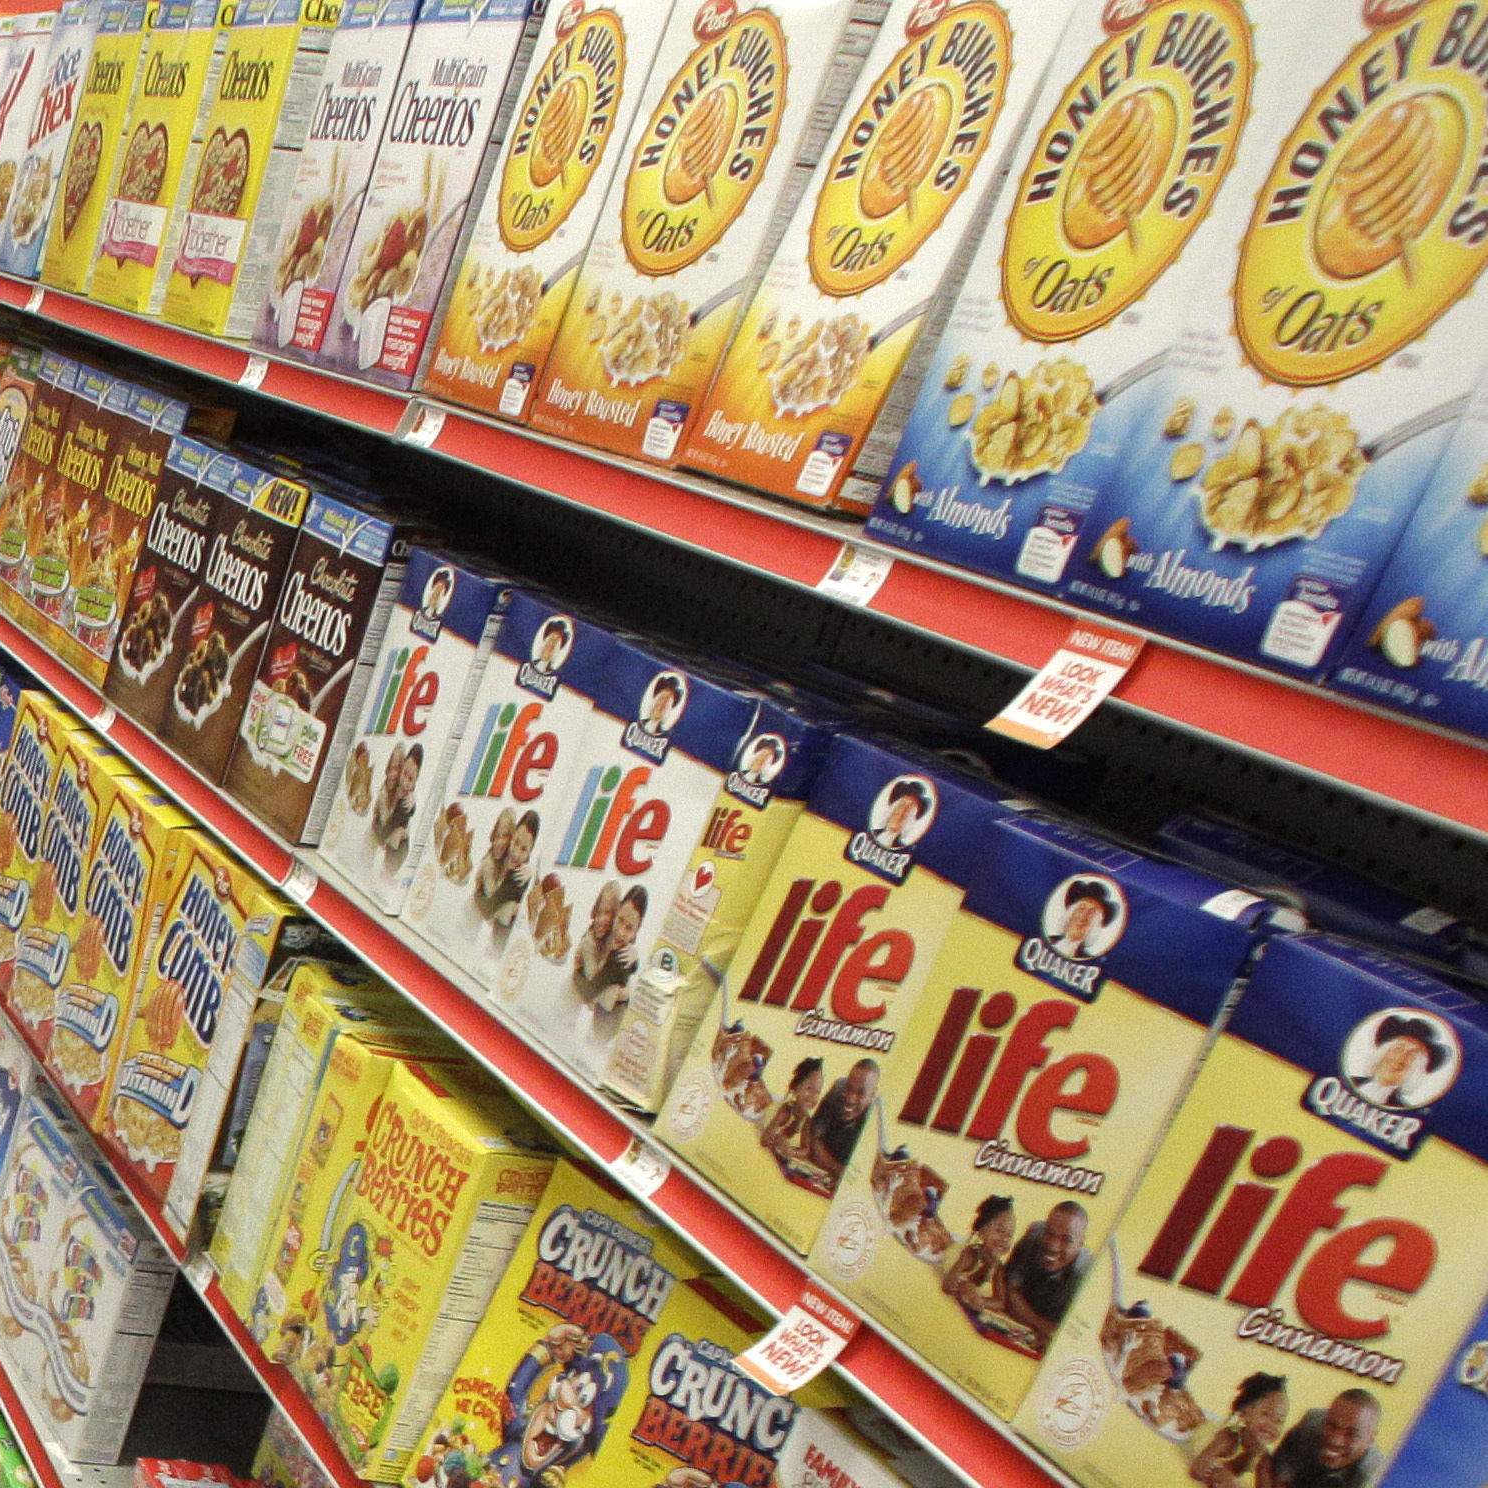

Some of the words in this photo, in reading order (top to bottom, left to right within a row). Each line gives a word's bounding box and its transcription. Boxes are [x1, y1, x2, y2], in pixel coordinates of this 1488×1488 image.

[219, 48, 272, 102] Cheerios
[428, 57, 487, 92] MultiGrain
[388, 81, 482, 149] Cheerios
[639, 39, 726, 172] HONEY
[723, 22, 779, 185] BUNCHES
[834, 40, 935, 182] HONEY
[939, 22, 998, 195] BUNCHES
[1025, 33, 1141, 208] HONEY
[1151, 12, 1235, 221] BUNCHES
[1262, 30, 1419, 229] HONEY
[543, 380, 581, 415] Honey
[582, 390, 642, 428] Roasted
[703, 405, 746, 443] Honey
[745, 420, 807, 462] Roasted
[265, 481, 298, 521] NEW!
[205, 532, 269, 612] Cheerios
[310, 556, 359, 602] Chocolate
[1149, 548, 1258, 617] Almonds
[279, 570, 353, 658] Cheerios
[1060, 657, 1105, 688] LOOK
[1071, 627, 1100, 652] NEW
[1102, 637, 1136, 661] ITEM!
[1018, 690, 1085, 727] NEW!
[1040, 676, 1097, 705] WHAT'S
[457, 701, 560, 803] life
[623, 723, 670, 760] QUAKER
[848, 831, 913, 878] QUAKER
[738, 878, 917, 1026] life
[1022, 938, 1103, 996] QUAKER
[156, 919, 225, 1049] COMB
[795, 1009, 896, 1053] Cinnamon
[897, 985, 1121, 1161] life
[1308, 1076, 1422, 1150] QUAKER
[973, 1139, 1106, 1195] Cinnamon
[1138, 1121, 1439, 1343] life
[758, 1341, 814, 1383] NEW!
[776, 1332, 824, 1365] WHAT'S
[791, 1320, 829, 1349] LOOK
[1236, 1305, 1405, 1387] Cinnamon
